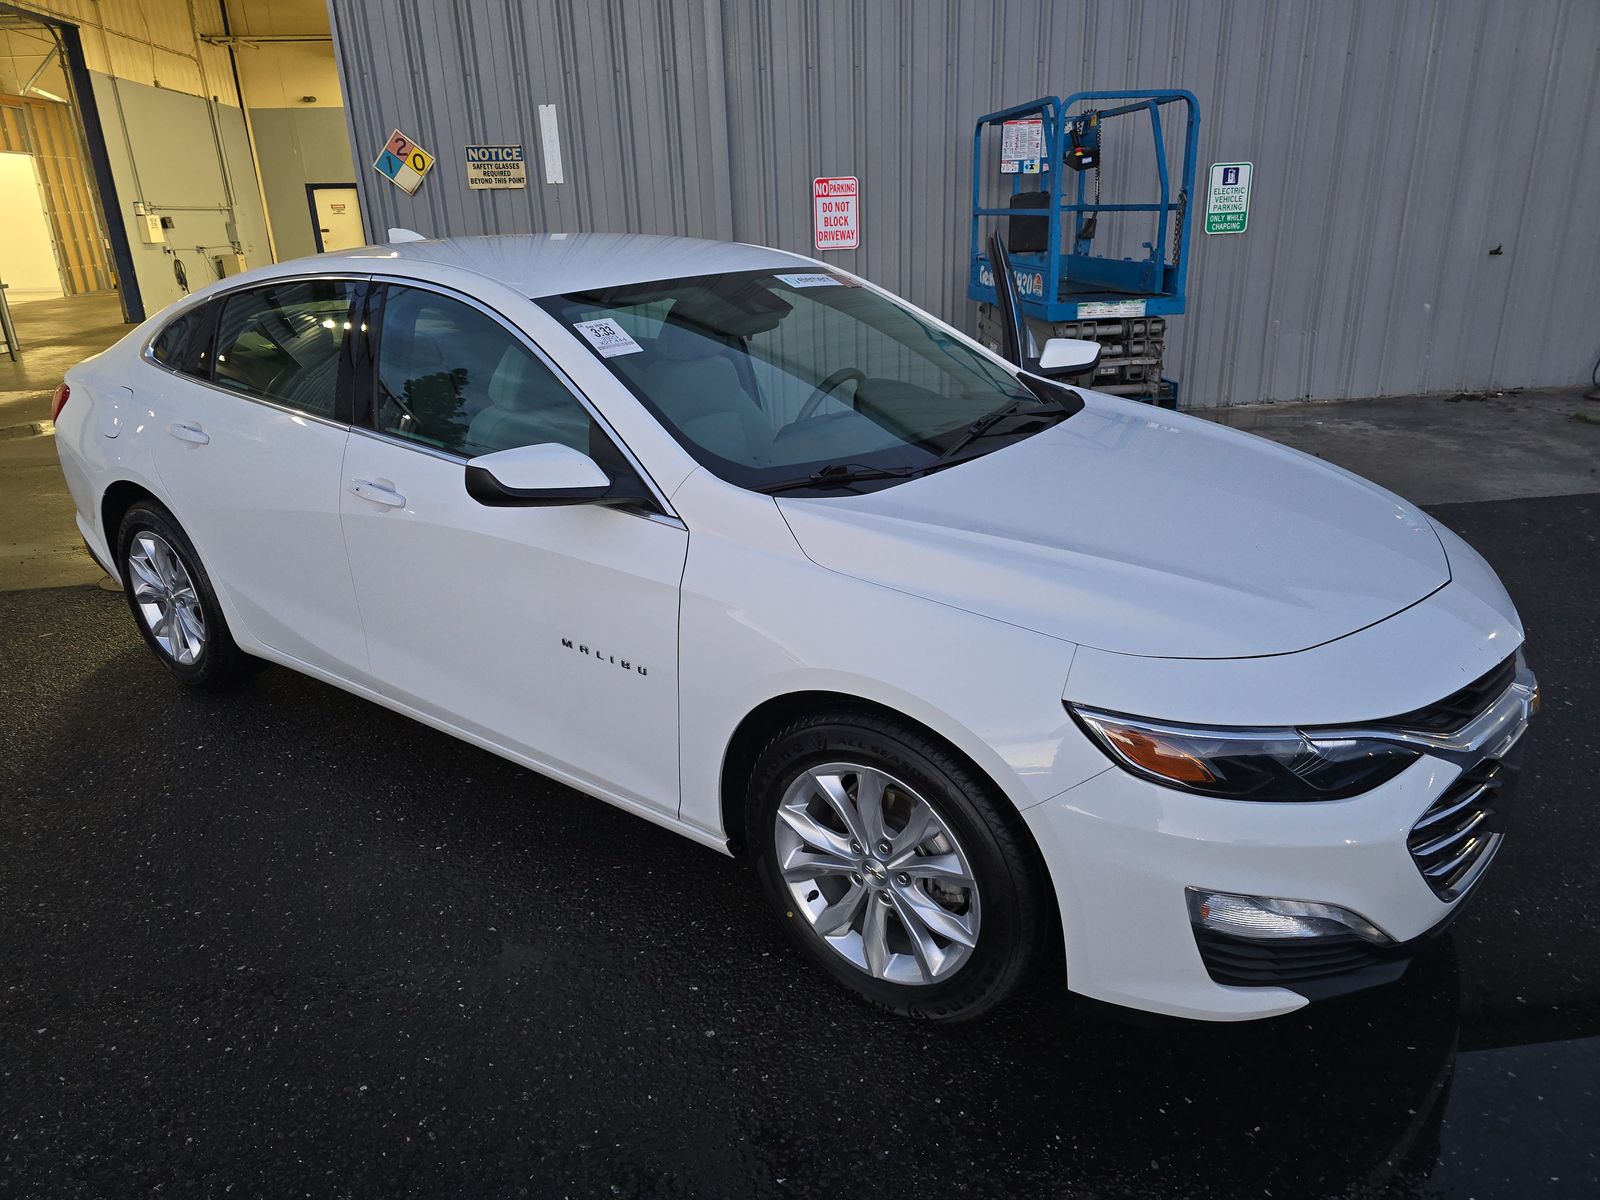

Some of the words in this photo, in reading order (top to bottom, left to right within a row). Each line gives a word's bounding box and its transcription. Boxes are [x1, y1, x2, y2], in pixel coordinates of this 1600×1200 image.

[395, 138, 408, 156] 2
[467, 148, 522, 161] NOTICE
[386, 156, 393, 174] 1
[413, 153, 425, 171] 0
[816, 182, 828, 196] NO
[829, 183, 855, 193] PARKING
[1213, 187, 1246, 196] ELECTRIC
[1214, 195, 1243, 204] VEHICLE
[822, 202, 833, 213] DO
[835, 201, 850, 213] NOT
[1213, 203, 1243, 212] PARKING
[824, 216, 849, 227] BLOCK
[1209, 214, 1226, 223] ONLY
[1226, 213, 1244, 222] WHILE
[1211, 222, 1241, 231] CHARGING
[818, 230, 855, 241] DRIVEWAY
[590, 326, 616, 338] 3:33
[561, 638, 648, 676] MALIBU
